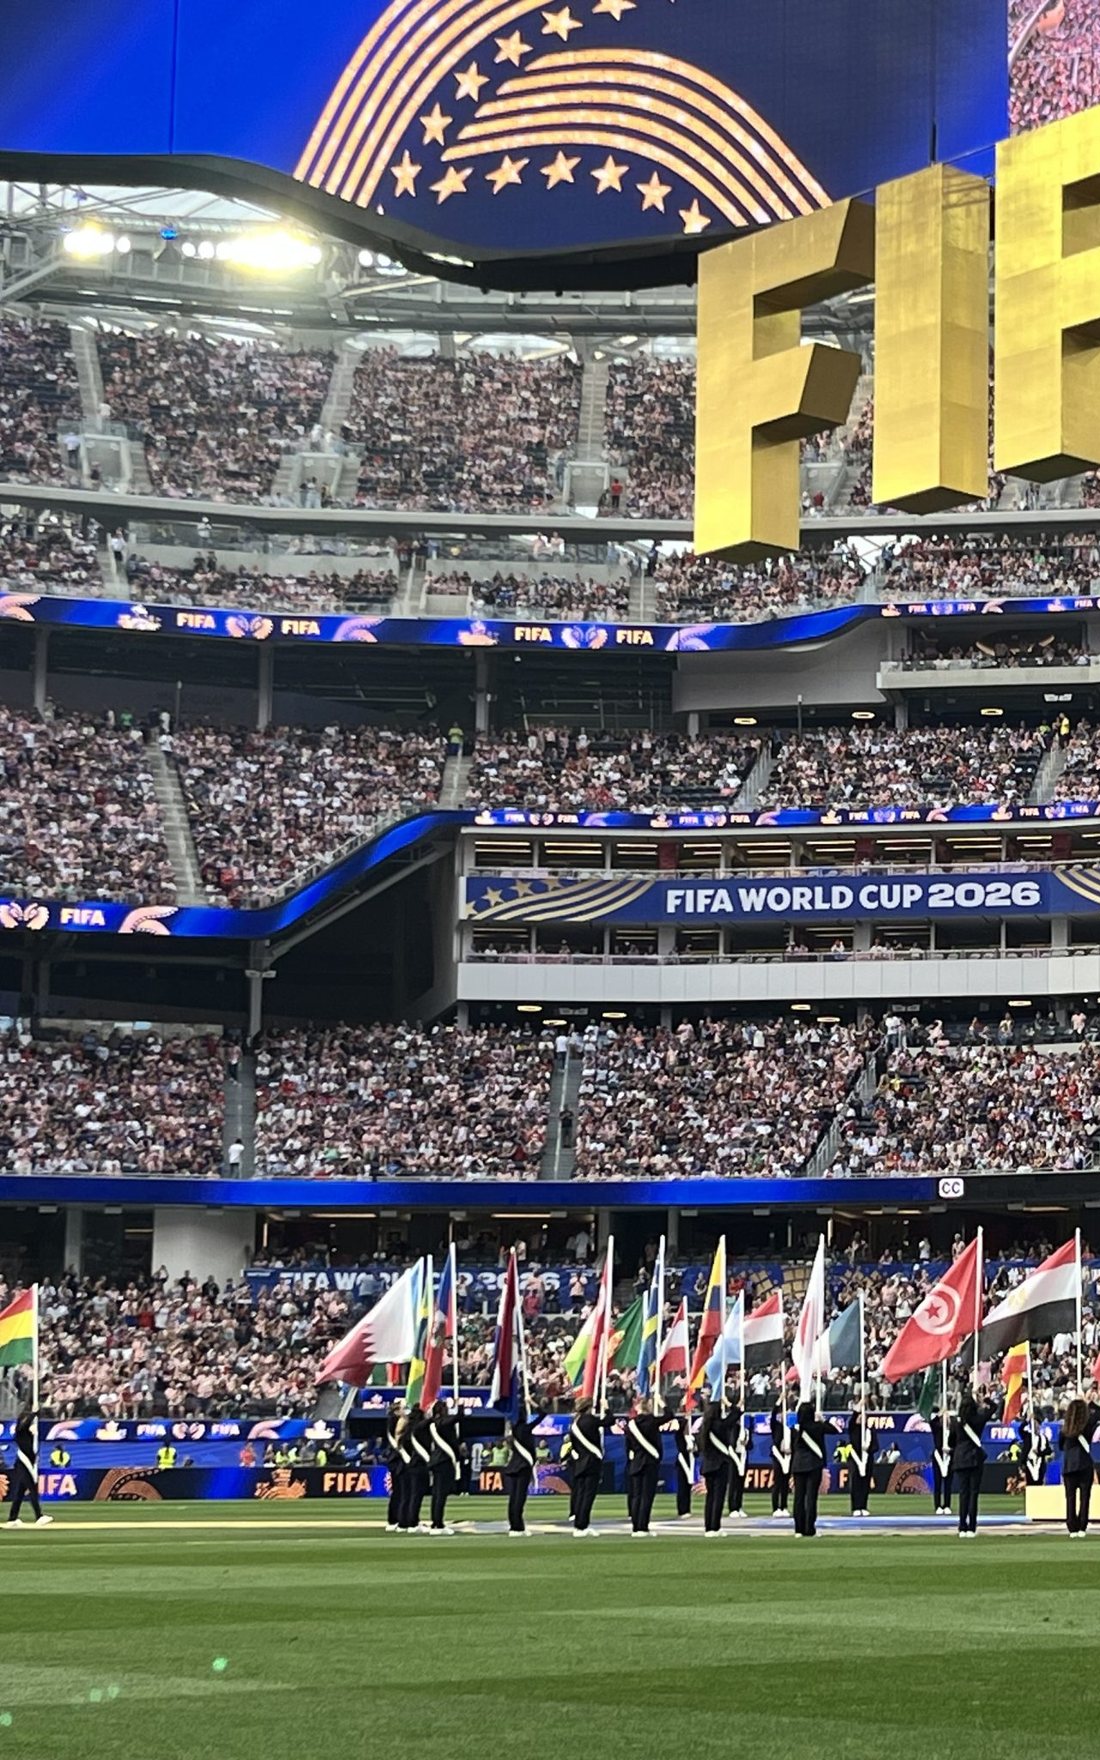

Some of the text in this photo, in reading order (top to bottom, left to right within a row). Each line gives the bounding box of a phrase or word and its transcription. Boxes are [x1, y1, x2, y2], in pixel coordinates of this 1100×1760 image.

[176, 612, 216, 629] FIFA
[281, 619, 320, 635] FIFA
[514, 626, 553, 643] FIFA
[616, 629, 654, 646] FIFA
[666, 881, 1041, 913] FIFA WORLD CUP 2026
[60, 908, 105, 926] FIFA
[942, 1182, 961, 1195] CC
[137, 1423, 166, 1436] FIFA
[211, 1423, 240, 1436] FIFA
[38, 1475, 77, 1496] IFA
[323, 1472, 371, 1493] FIFA
[480, 1471, 504, 1491] IFA
